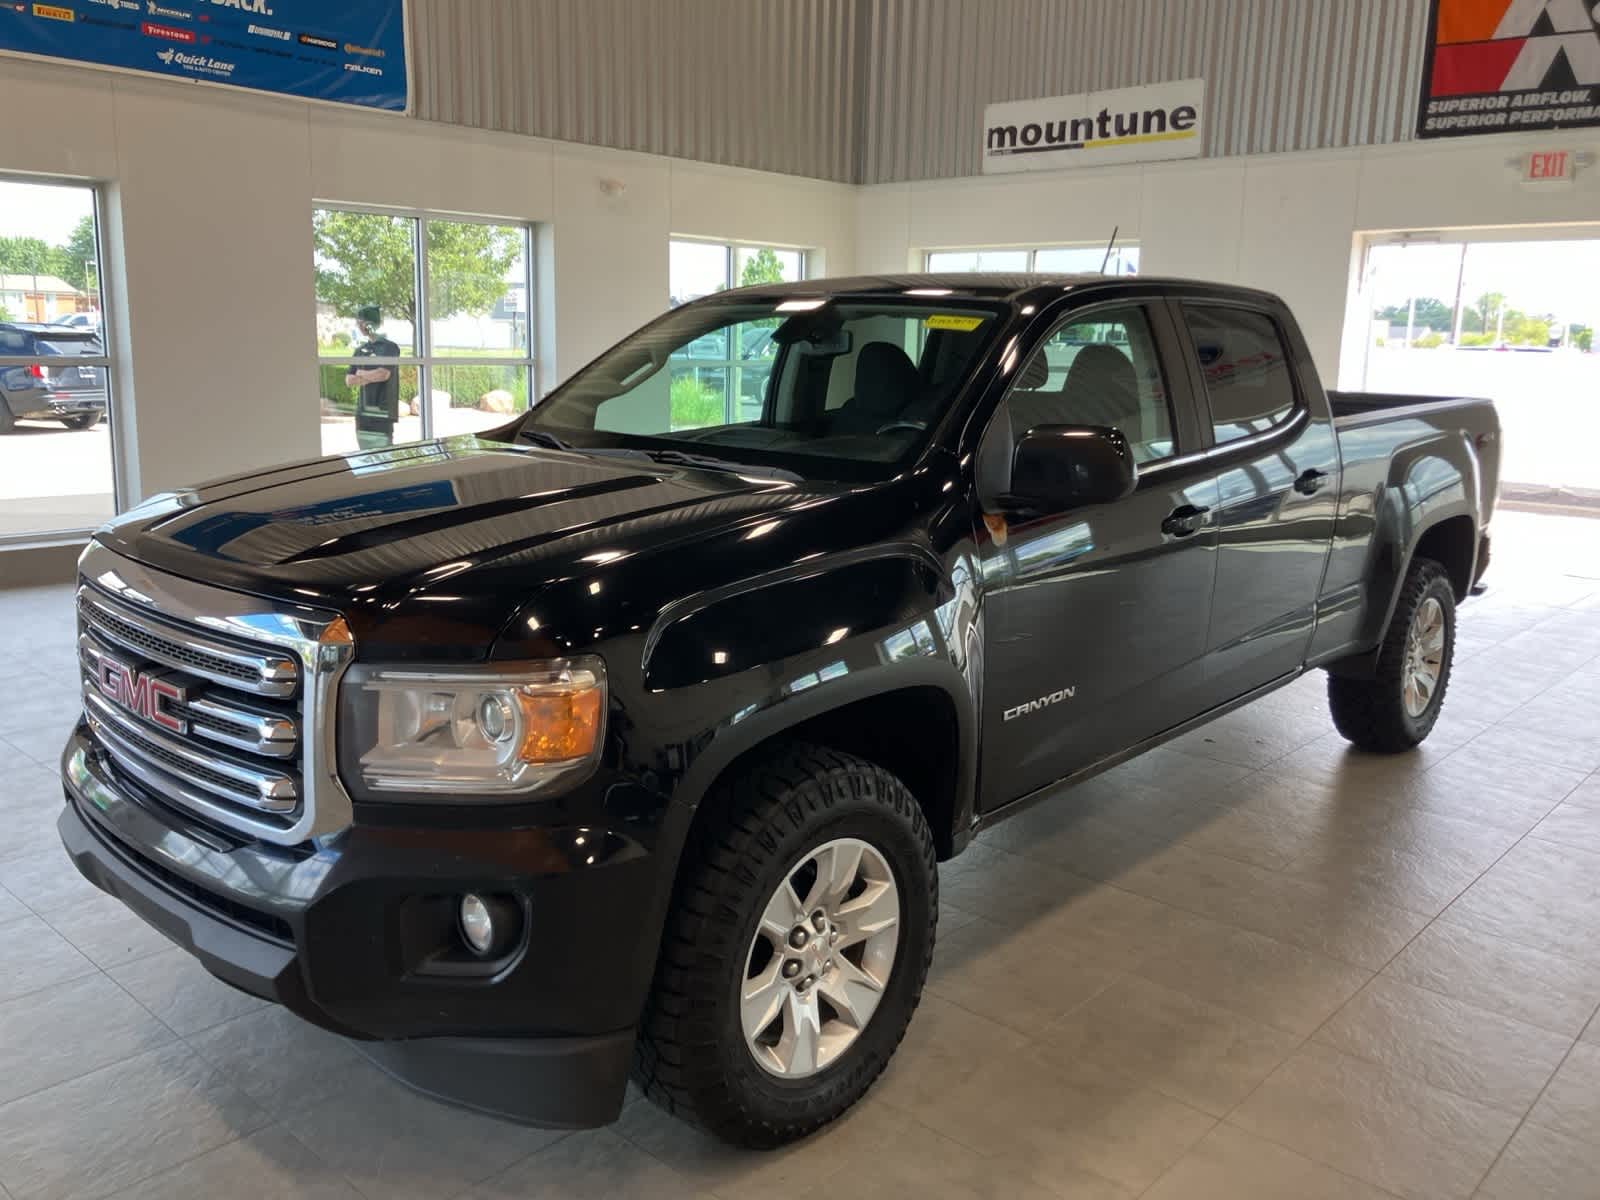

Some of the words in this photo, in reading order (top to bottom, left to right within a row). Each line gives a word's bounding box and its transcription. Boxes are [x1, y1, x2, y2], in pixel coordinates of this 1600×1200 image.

[175, 52, 207, 67] Quick
[207, 58, 236, 72] Lane
[344, 63, 383, 76] FALKEN
[1427, 95, 1510, 115] SUPERIOR
[1511, 89, 1591, 108] AIRFLOW.
[987, 105, 1197, 149] mountune
[1425, 112, 1507, 131] SUPERIOR
[1529, 150, 1569, 179] EXIT
[97, 655, 188, 735] GMC
[1003, 686, 1076, 721] CANYON
